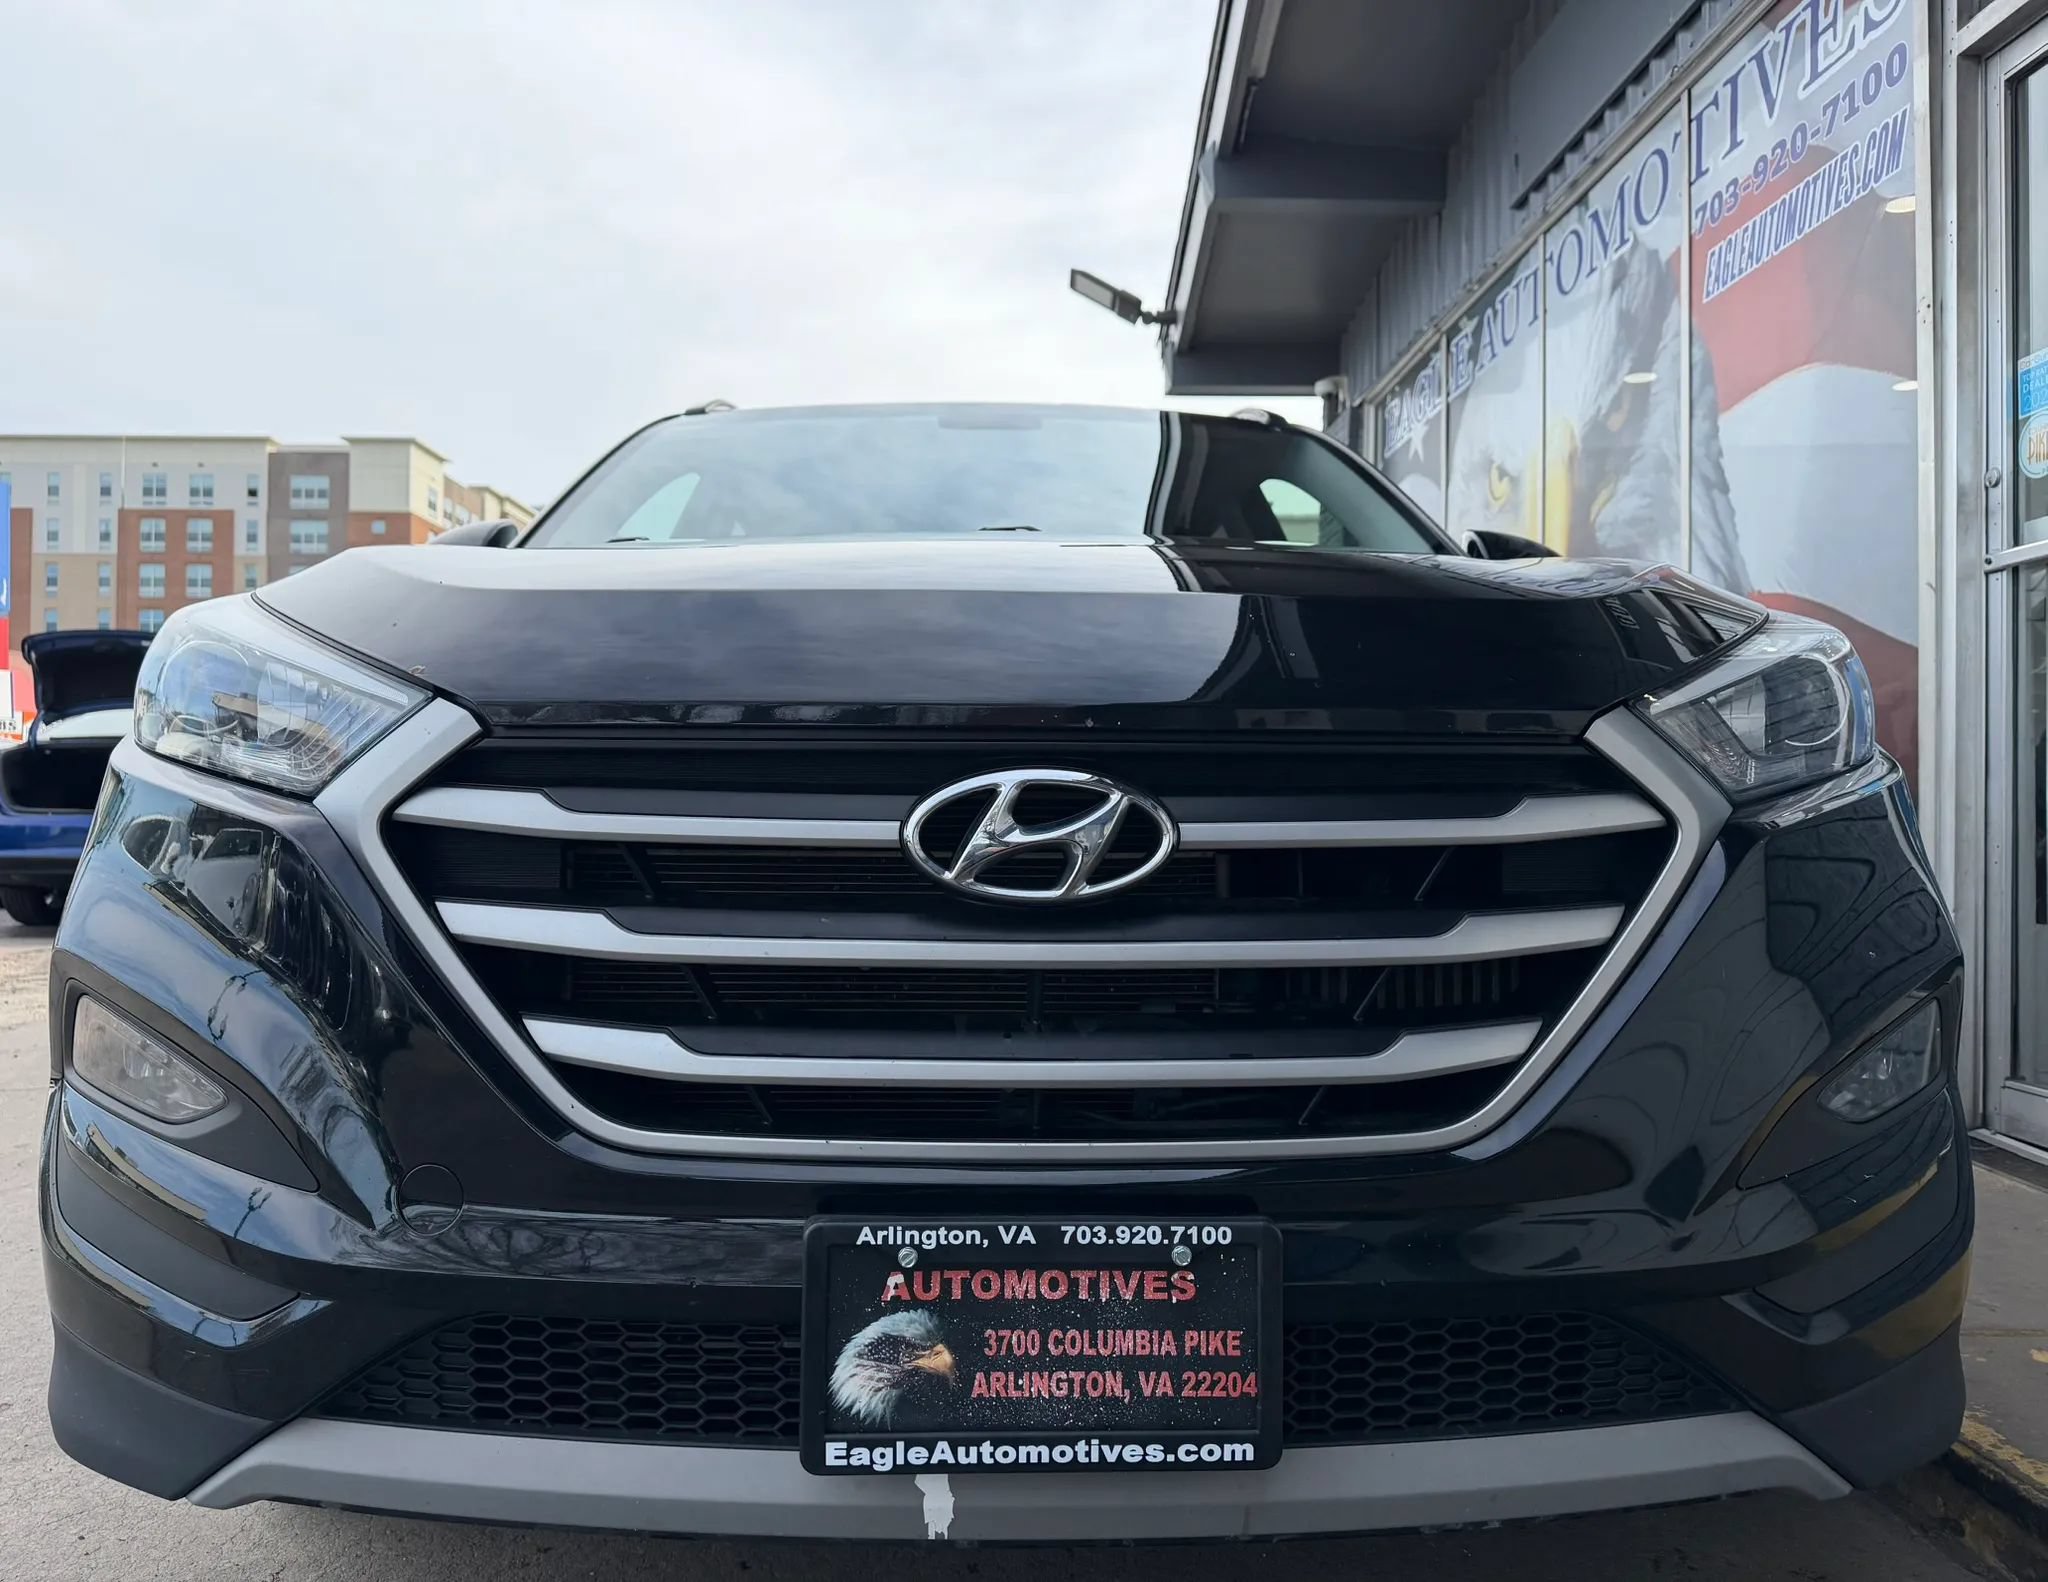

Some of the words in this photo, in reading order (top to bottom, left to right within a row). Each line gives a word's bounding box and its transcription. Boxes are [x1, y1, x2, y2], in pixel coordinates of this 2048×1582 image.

[1695, 42, 1908, 238] 703-920-7100
[1704, 106, 1909, 301] EAGLEAUTOMOTIVES.COM
[1385, 331, 1475, 454] EAGLE
[856, 1226, 988, 1249] Arlington,
[998, 1227, 1036, 1245] VA
[1061, 1226, 1232, 1245] 703.920.7100
[882, 1269, 1198, 1301] AUTOMOTIVES
[983, 1329, 1041, 1356] 3700
[1048, 1329, 1177, 1357] COLUMBIA
[1184, 1330, 1242, 1356] PIKE
[971, 1371, 1130, 1401] ARLINGTON,
[1139, 1371, 1174, 1398] VA
[1181, 1371, 1258, 1398] 22204
[825, 1440, 1255, 1472] EagleAutomotives.com
